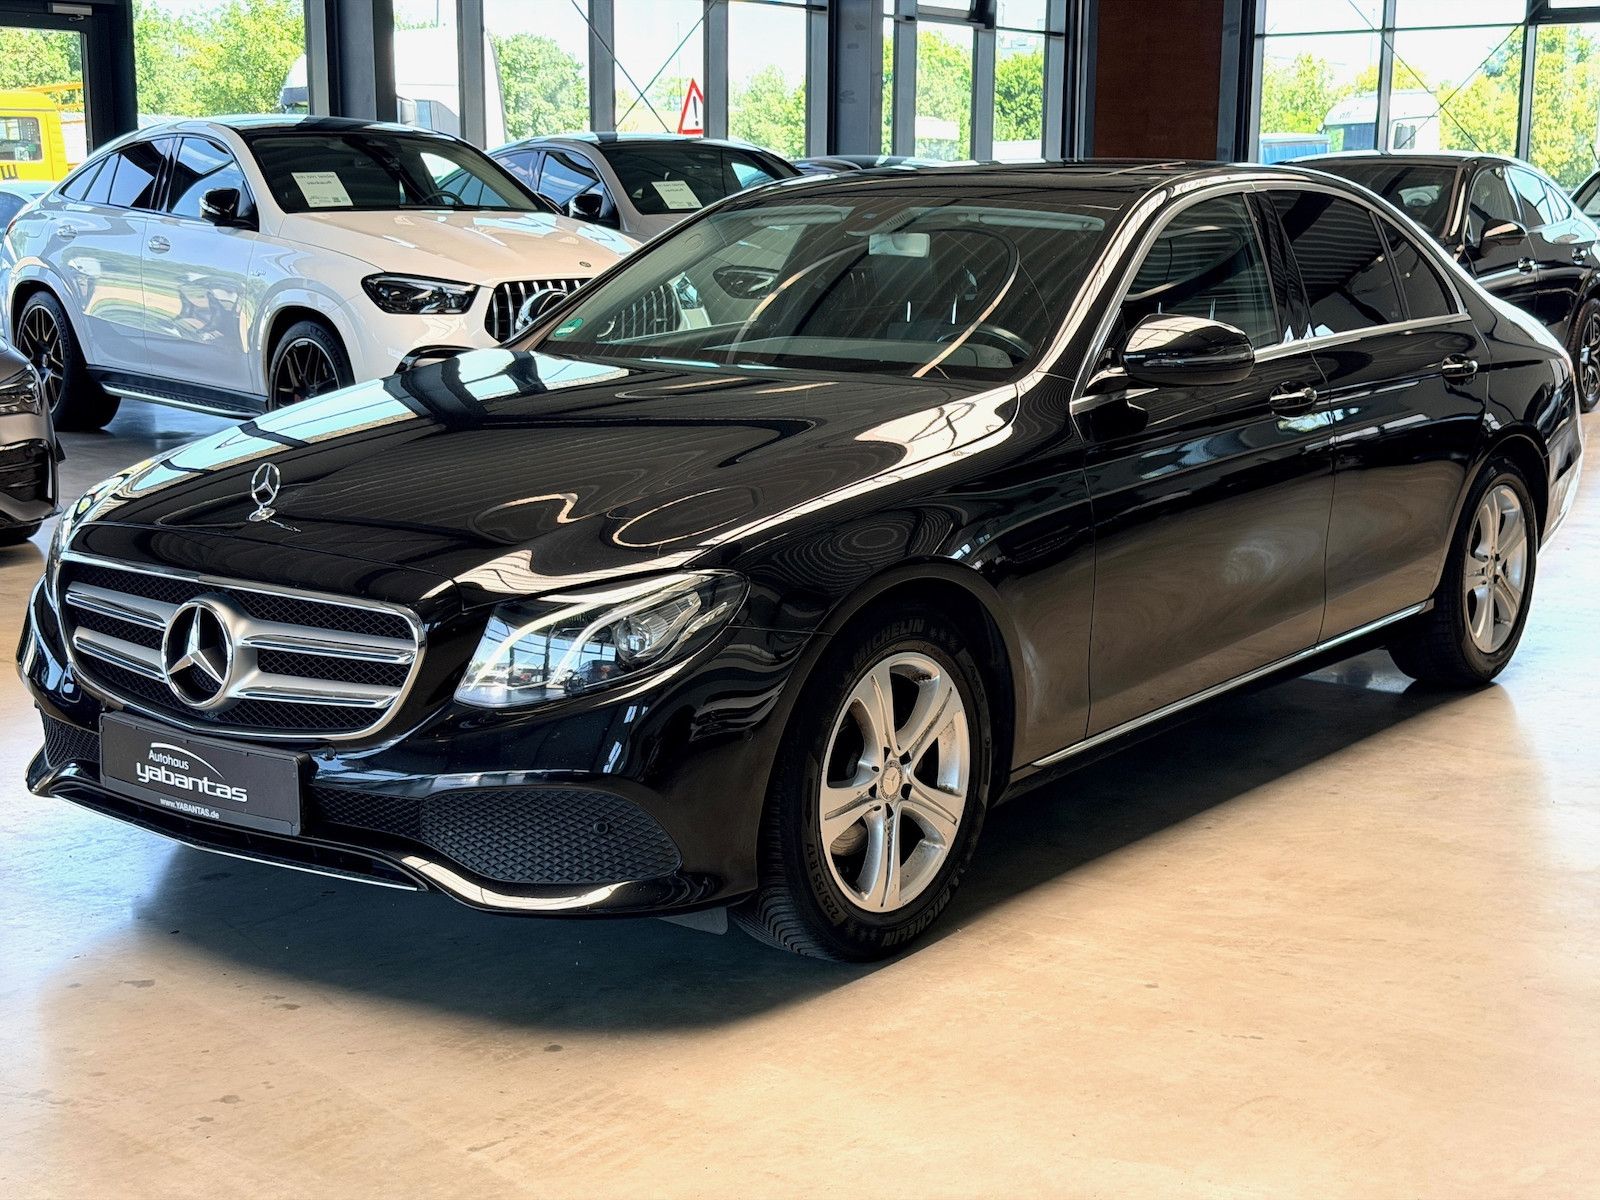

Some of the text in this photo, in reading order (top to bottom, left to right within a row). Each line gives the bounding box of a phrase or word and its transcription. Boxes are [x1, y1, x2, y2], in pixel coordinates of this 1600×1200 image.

[852, 617, 926, 667] MICHELIN
[136, 762, 248, 803] yabantas
[148, 750, 190, 771] Autohaus
[160, 798, 220, 820] www.YABANTAS.de
[807, 843, 840, 919] 225/55 R 17
[881, 888, 952, 948] MICHELIN
